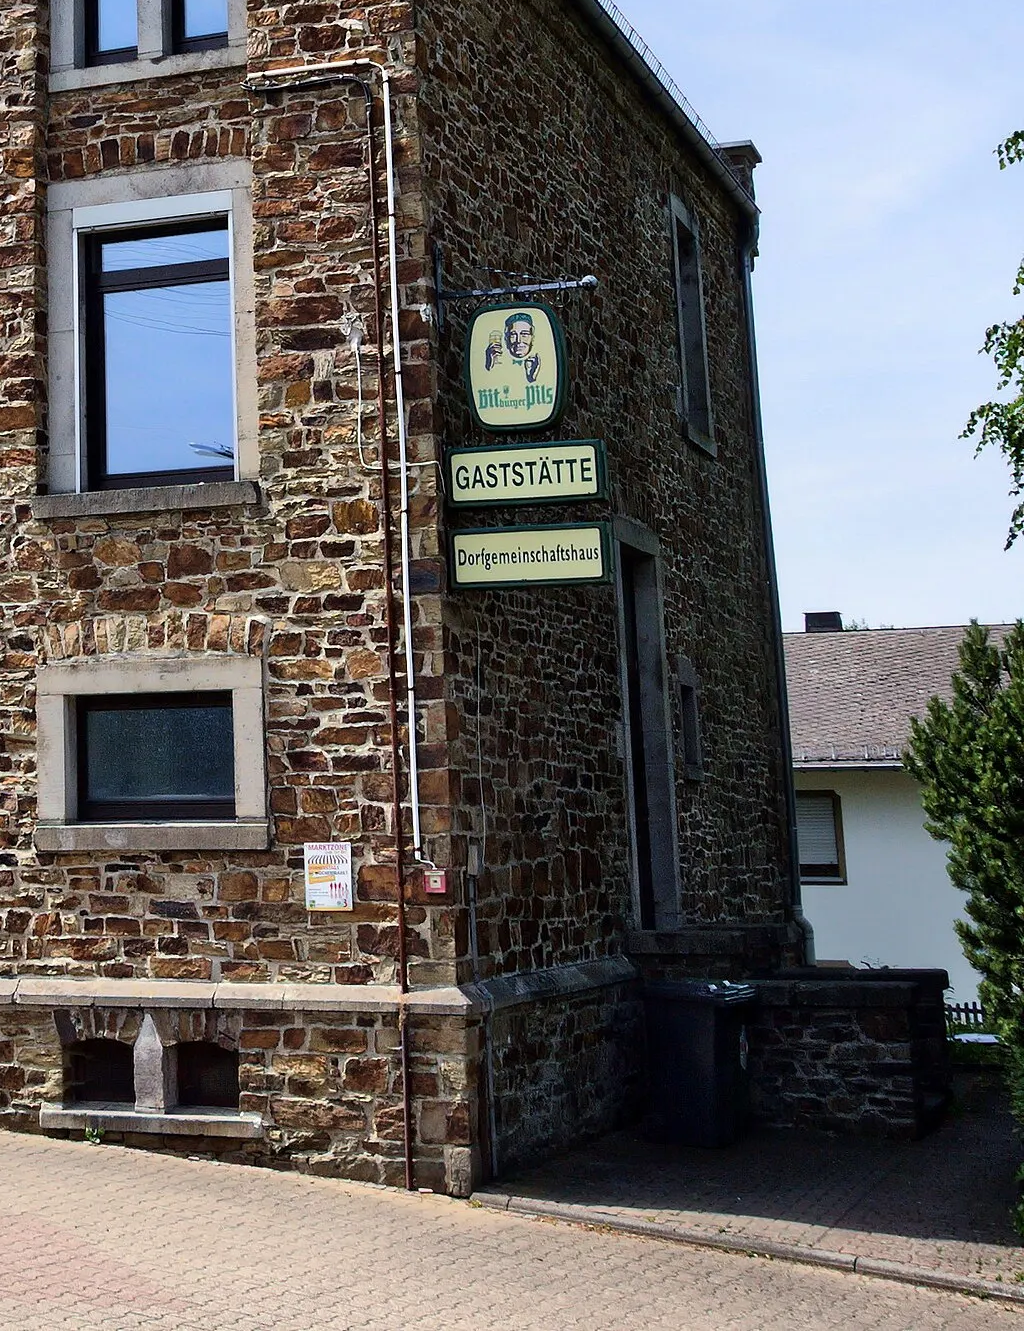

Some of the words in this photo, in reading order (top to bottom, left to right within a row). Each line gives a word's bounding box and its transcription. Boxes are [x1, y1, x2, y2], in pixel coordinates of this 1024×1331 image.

[478, 388, 526, 409] Bitburger
[525, 384, 553, 411] Pils
[455, 457, 593, 490] GASTSTÄTTE
[458, 544, 599, 570] Dorfgemeinschaftshaus
